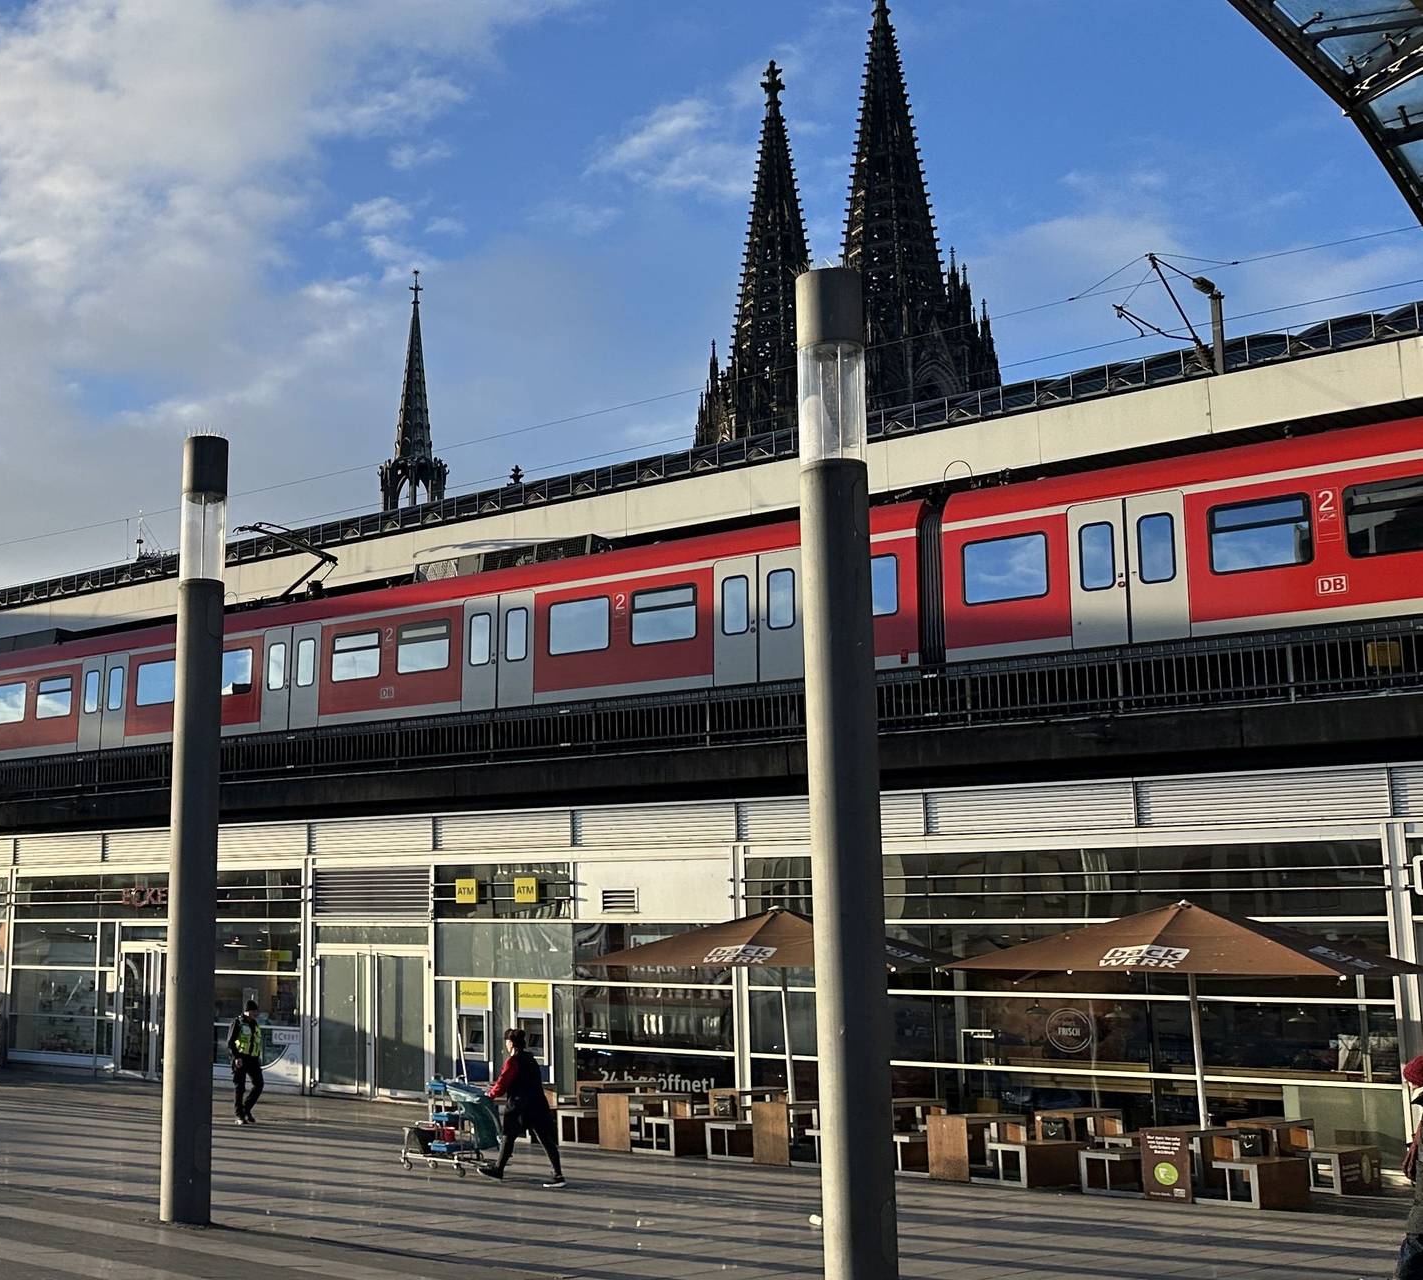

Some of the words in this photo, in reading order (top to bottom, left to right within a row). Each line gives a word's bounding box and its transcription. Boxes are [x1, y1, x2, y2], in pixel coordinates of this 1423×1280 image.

[1318, 490, 1335, 512] 2
[1318, 577, 1346, 593] DB
[615, 593, 626, 610] 2
[385, 627, 394, 642] 2
[380, 687, 395, 699] DB
[457, 887, 474, 895] ATM
[517, 886, 534, 895] ATM
[122, 887, 169, 907] ECKE
[710, 946, 772, 958] back
[1108, 948, 1182, 959] back
[1099, 958, 1180, 969] WERK
